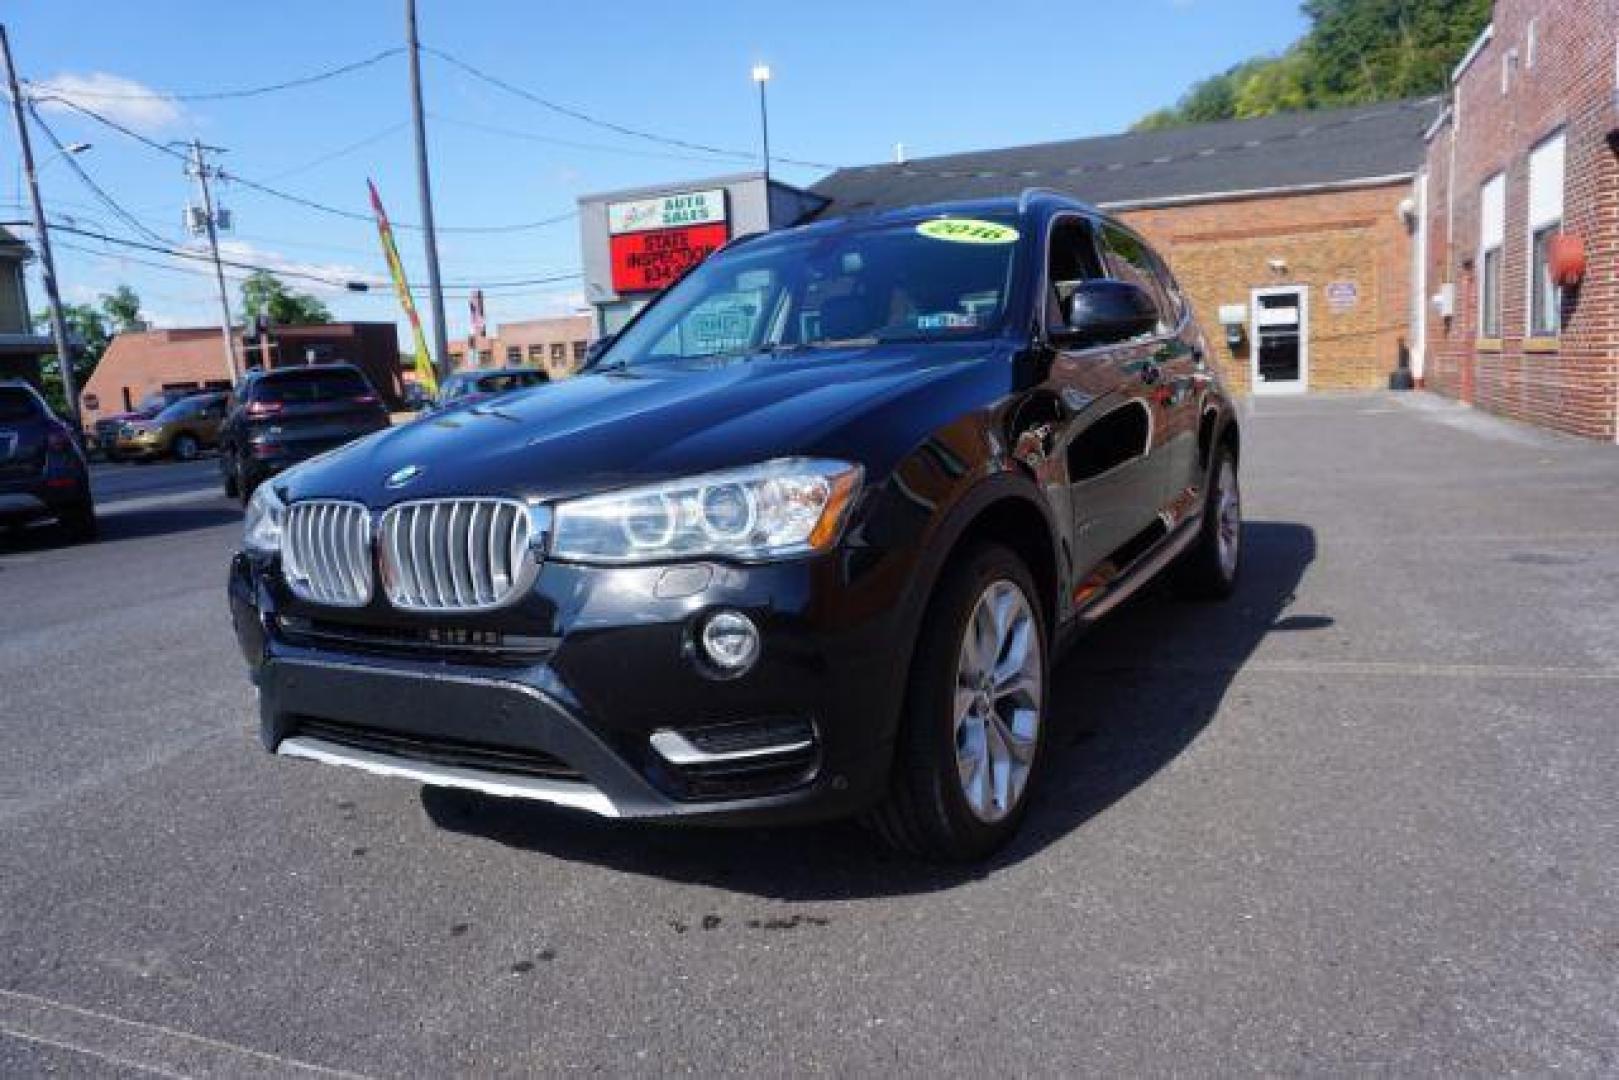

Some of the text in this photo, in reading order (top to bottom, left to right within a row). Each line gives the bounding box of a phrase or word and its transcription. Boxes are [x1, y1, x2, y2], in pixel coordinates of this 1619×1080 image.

[664, 195, 705, 211] AUTO
[662, 209, 710, 224] SALES
[926, 221, 1008, 240] 2016
[644, 231, 690, 252] STATE
